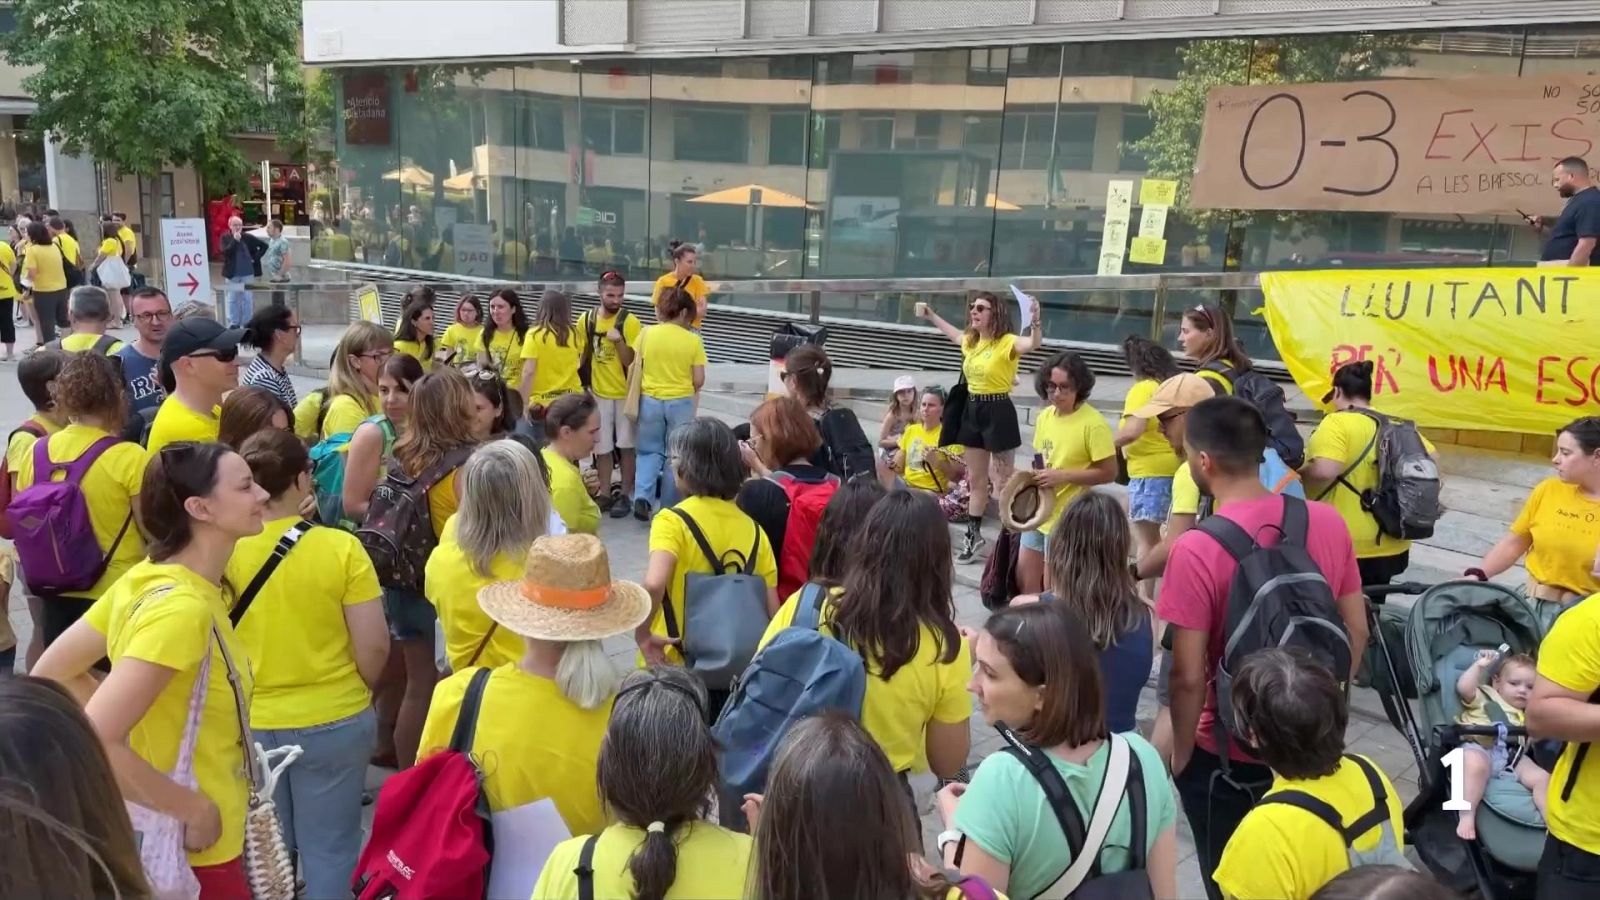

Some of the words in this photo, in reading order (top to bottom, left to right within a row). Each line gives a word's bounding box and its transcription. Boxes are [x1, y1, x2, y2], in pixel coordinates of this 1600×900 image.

[1543, 84, 1561, 99] NO
[1240, 91, 1399, 196] 0-3
[1424, 108, 1600, 165] EXIS
[1416, 175, 1433, 196] A
[1443, 173, 1470, 194] LES
[170, 252, 203, 267] OAC
[1340, 275, 1580, 320] LLUITANT
[1427, 353, 1510, 395] UNA
